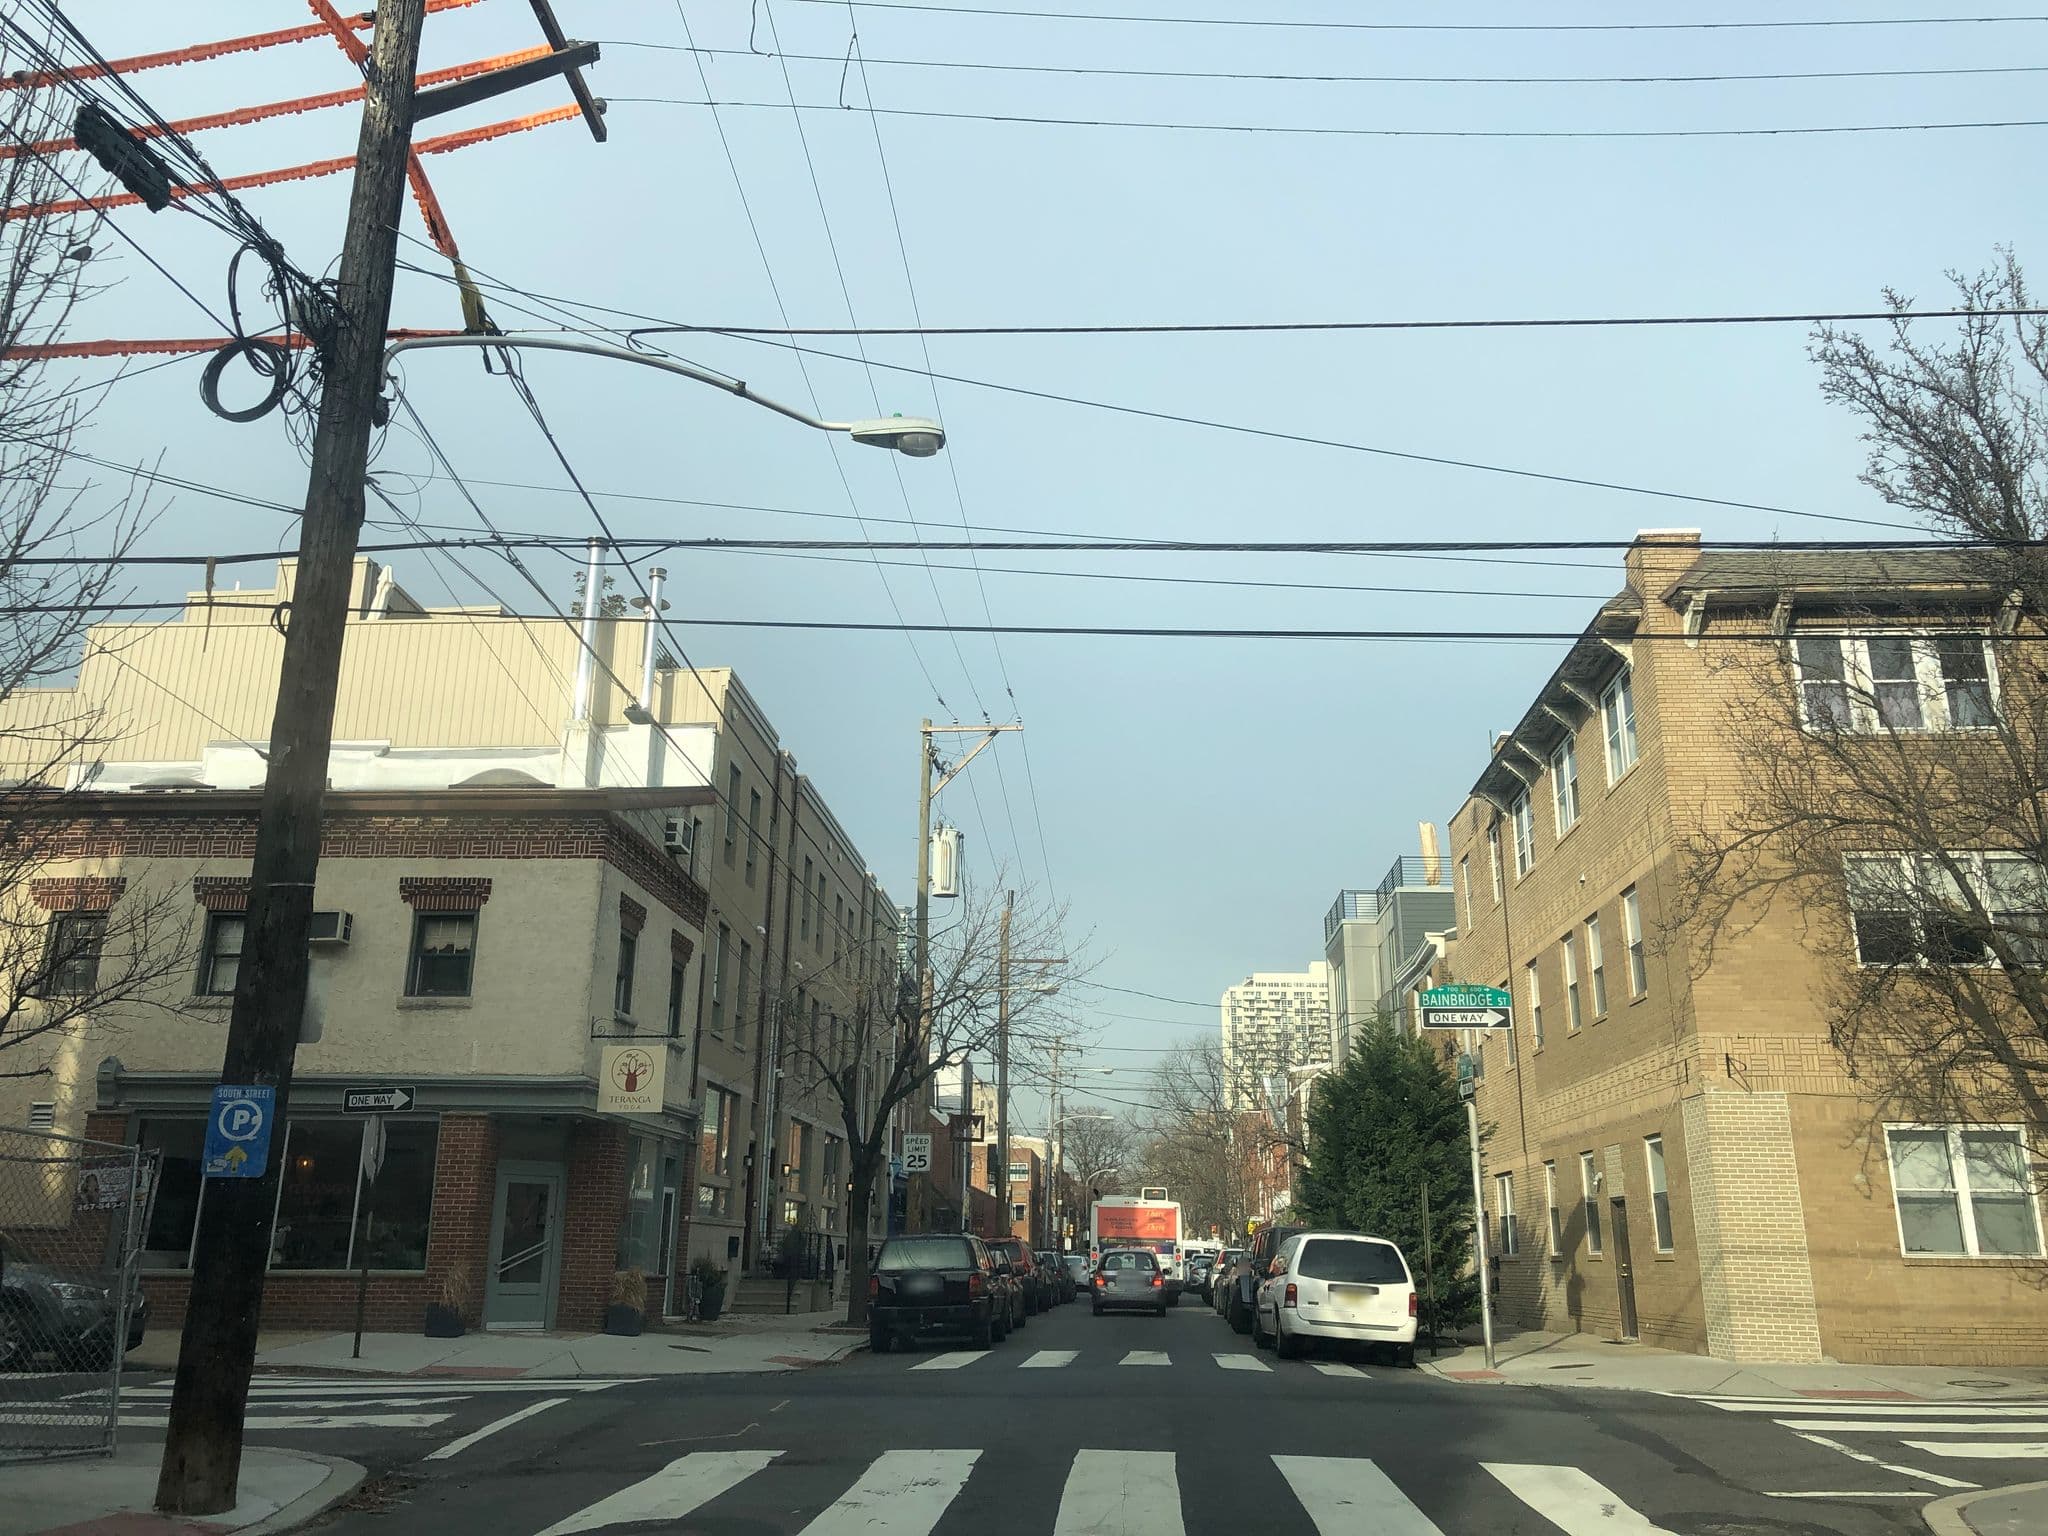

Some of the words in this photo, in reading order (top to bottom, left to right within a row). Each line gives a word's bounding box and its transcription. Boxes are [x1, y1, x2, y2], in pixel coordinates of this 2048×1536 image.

[1422, 993, 1493, 1006] BAINBRIDGE
[1497, 997, 1507, 1006] ST
[1433, 1013, 1457, 1022] ONE
[1460, 1013, 1484, 1022] WAY
[218, 1088, 241, 1098] SOUTH
[245, 1089, 270, 1099] STREET
[351, 1096, 370, 1105] ONE
[373, 1095, 393, 1105] WAY
[609, 1095, 651, 1104] TERANGA
[232, 1109, 250, 1131] P
[906, 1155, 927, 1168] 25
